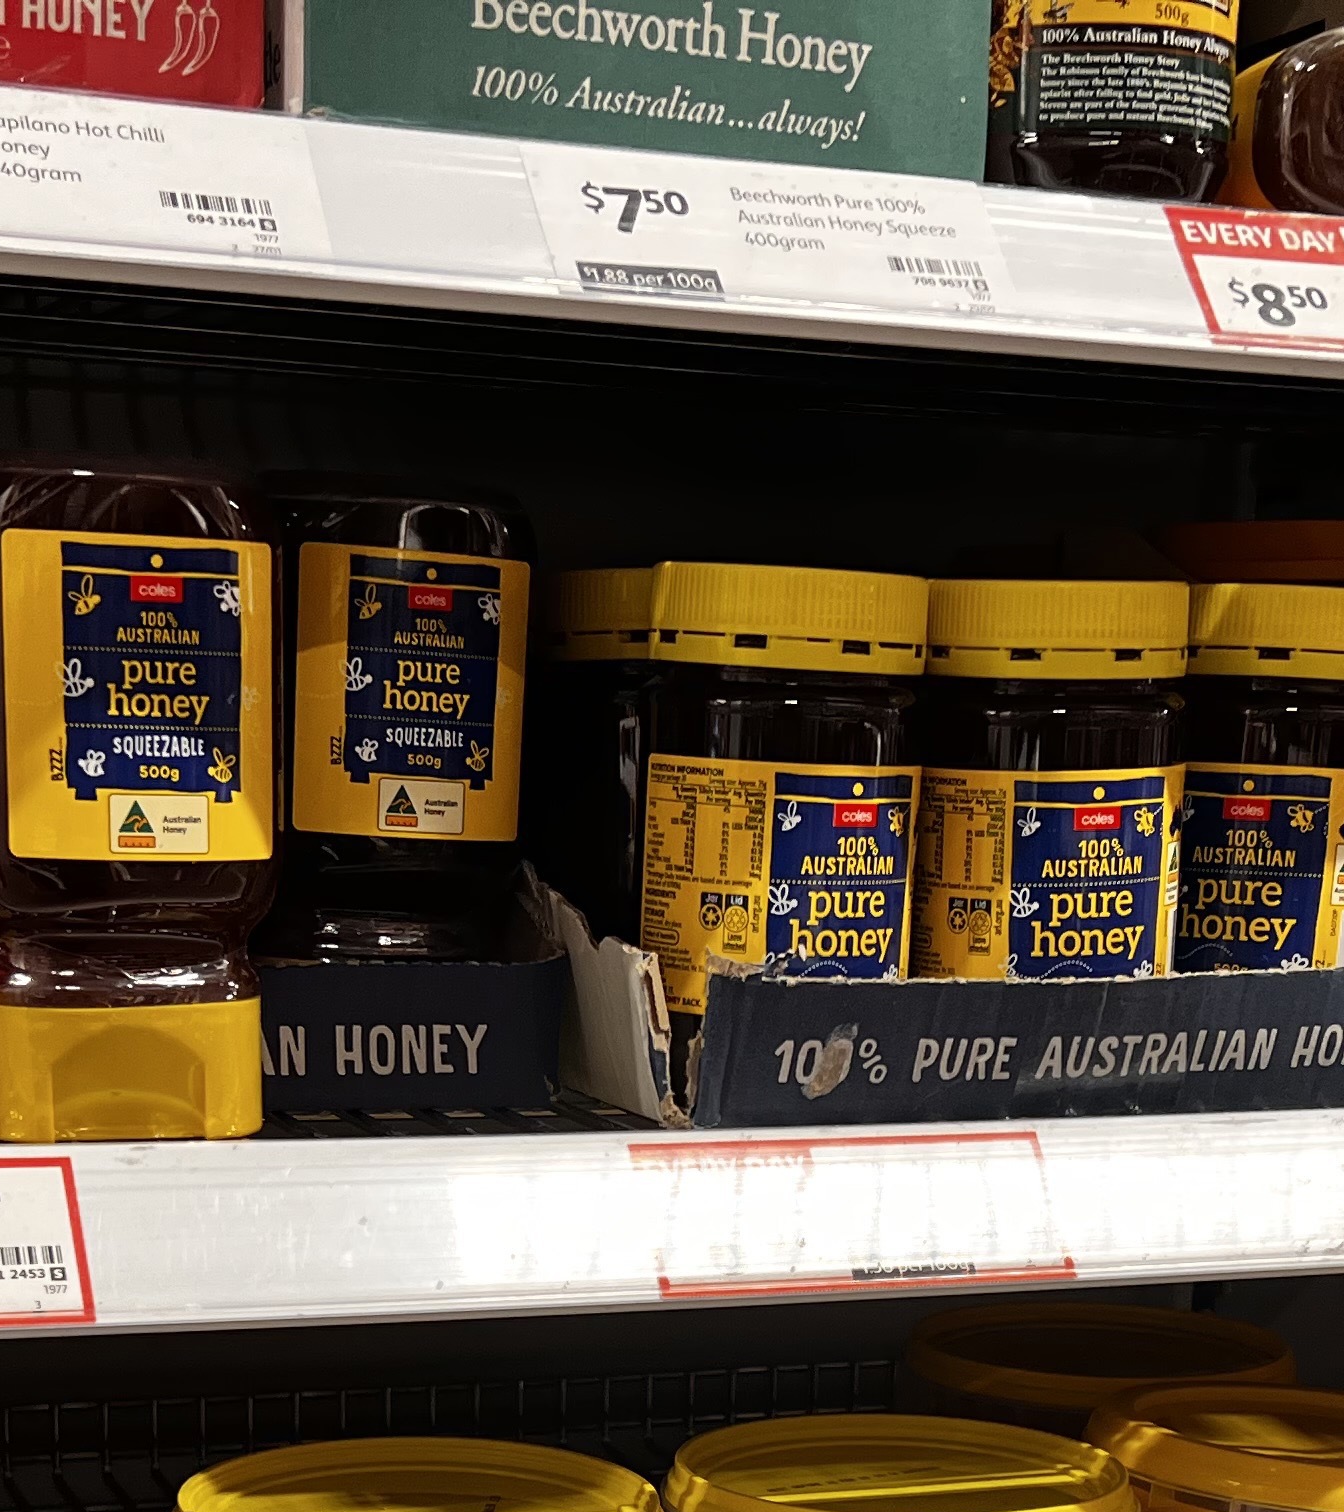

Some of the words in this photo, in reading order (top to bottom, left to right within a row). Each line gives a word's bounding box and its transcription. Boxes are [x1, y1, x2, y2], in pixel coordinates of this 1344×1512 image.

[736, 11, 874, 92] Honey
[471, 65, 560, 105] 100%
[75, 119, 113, 139] Hot
[116, 123, 166, 144] Chilli
[1179, 220, 1272, 250] EVERY
[1279, 229, 1336, 253] DAY
[139, 610, 179, 629] 100%
[115, 627, 202, 647] AUSTRALIAN
[121, 657, 197, 691] pure
[106, 685, 211, 724] honey
[112, 735, 206, 760] SQUEEZABLE
[138, 762, 180, 783] 500g
[841, 809, 872, 823] coles
[837, 835, 879, 856] 100%
[799, 853, 895, 877] AUSTRALIAN
[806, 890, 885, 924] pure
[788, 917, 892, 964] honey
[912, 1036, 1019, 1083] PURE
[1036, 1027, 1277, 1080] AUSTRALIAN
[10, 1269, 45, 1280] 2453
